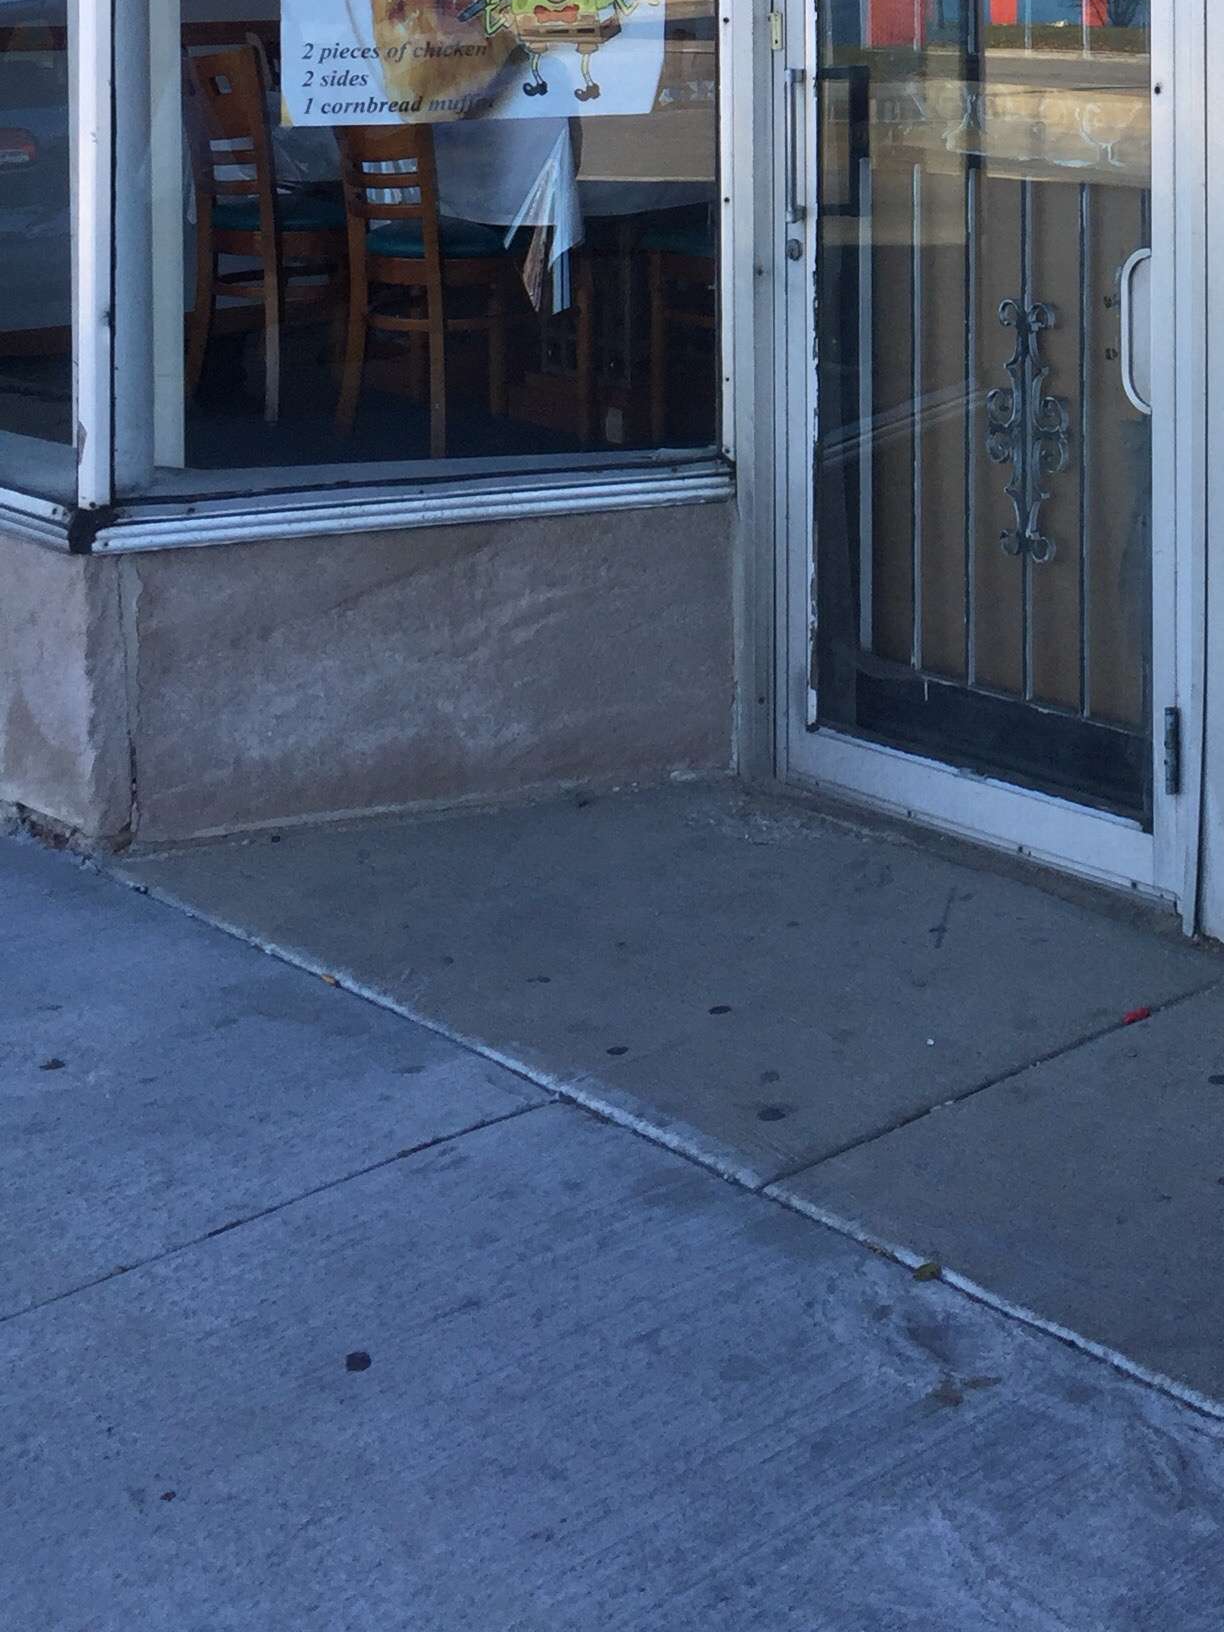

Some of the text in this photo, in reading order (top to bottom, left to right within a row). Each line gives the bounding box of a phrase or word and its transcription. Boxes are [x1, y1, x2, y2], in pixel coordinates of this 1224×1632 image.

[302, 39, 487, 64] 2 pieces of chicken
[302, 71, 369, 87] 2 sides
[303, 98, 313, 114] 1
[321, 96, 423, 114] cornbread
